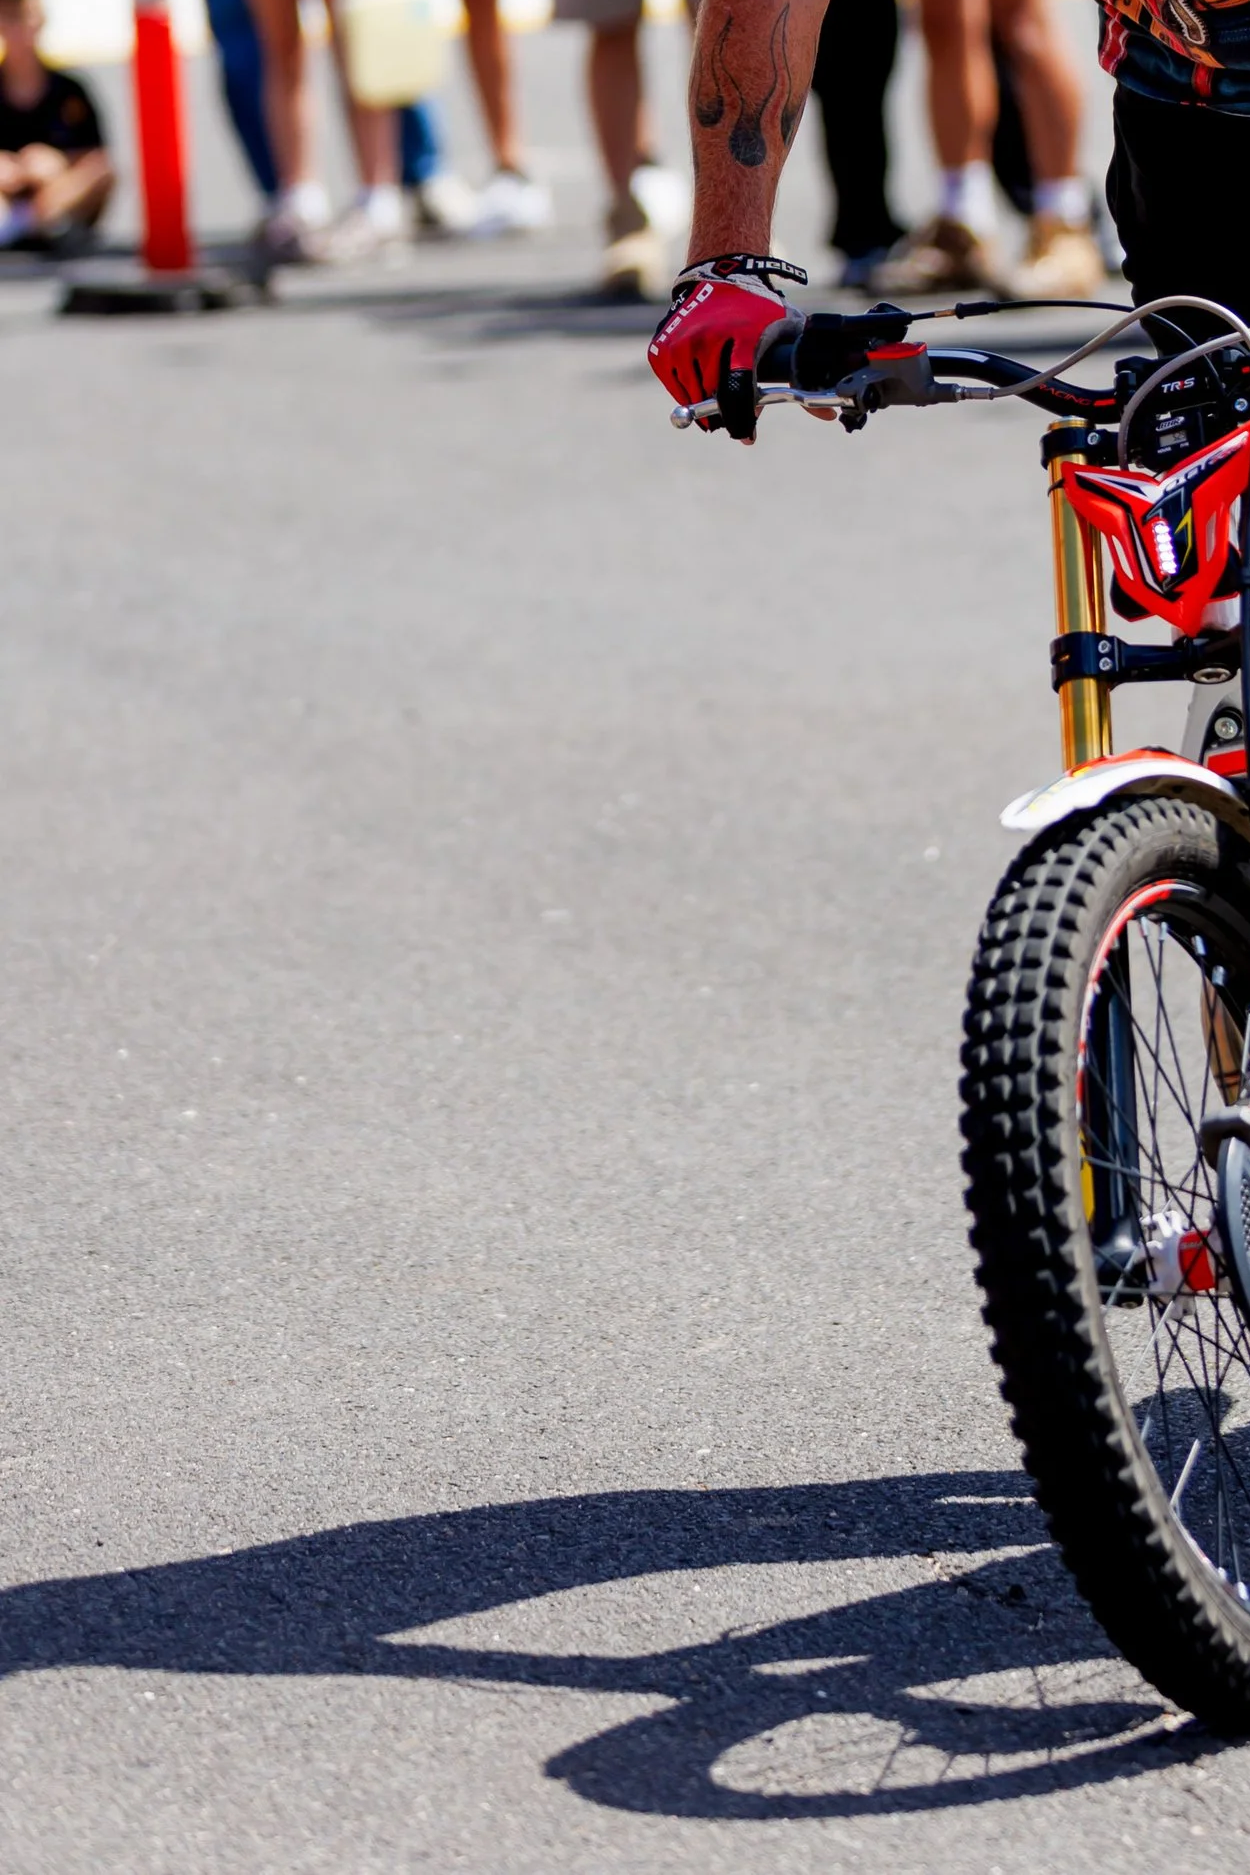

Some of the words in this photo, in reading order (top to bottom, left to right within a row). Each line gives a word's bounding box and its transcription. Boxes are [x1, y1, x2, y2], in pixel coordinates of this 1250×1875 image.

[745, 258, 806, 279] hebo
[649, 282, 714, 357] hebo
[1038, 382, 1093, 406] RACING
